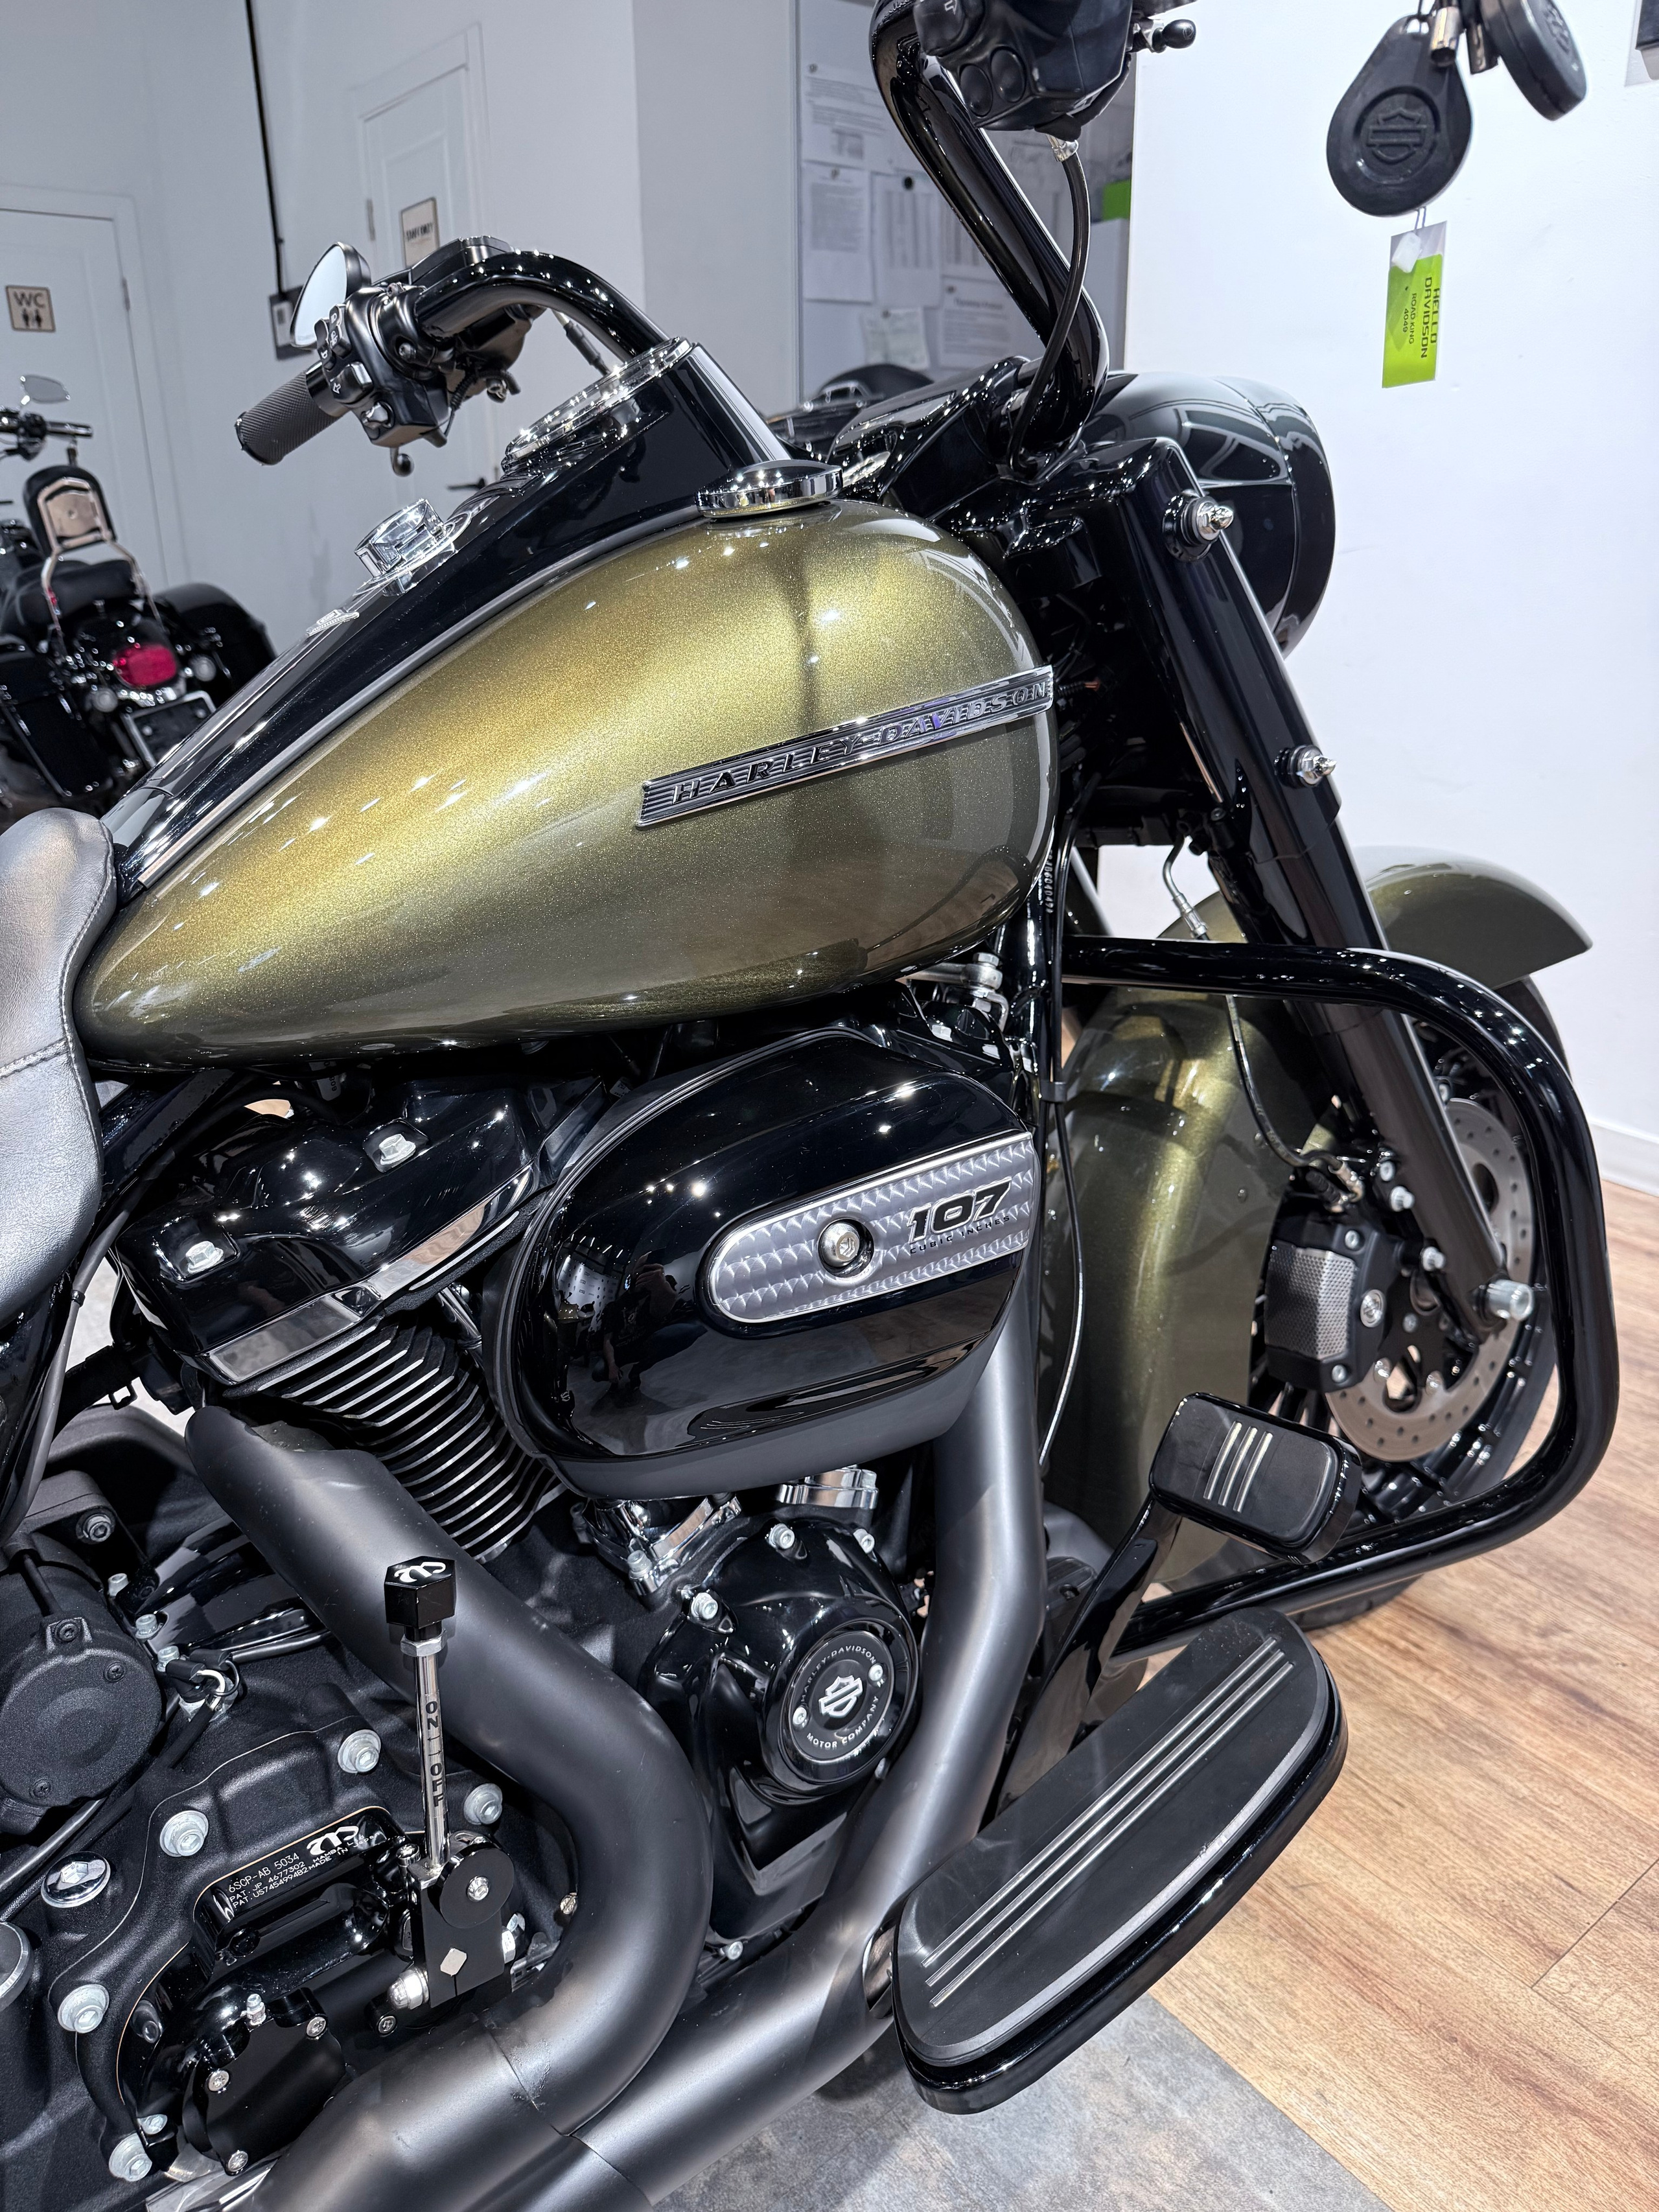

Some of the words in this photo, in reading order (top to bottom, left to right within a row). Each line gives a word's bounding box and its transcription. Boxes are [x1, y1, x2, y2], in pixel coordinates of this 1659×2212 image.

[13, 291, 45, 309] WC
[1421, 277, 1433, 358] DAVIDSON
[1430, 288, 1440, 343] HELLO
[672, 682, 1046, 805] HARLEY-DAVIDSON
[907, 1176, 1012, 1244] 107
[909, 1235, 953, 1254] CUBIC
[961, 1215, 1010, 1237] INCHES
[800, 1645, 877, 1702] HARLEY-DAVIDSON
[424, 1701, 440, 1730] ON
[806, 1732, 838, 1749] MOTOR
[841, 1695, 879, 1745] COMPANY
[430, 1762, 444, 1808] OFF
[268, 1861, 306, 1882] 4677302
[274, 1852, 300, 1870] 5034
[308, 1856, 332, 1870] MADE
[338, 1847, 349, 1856] IN
[312, 1846, 343, 1863] MAMBA
